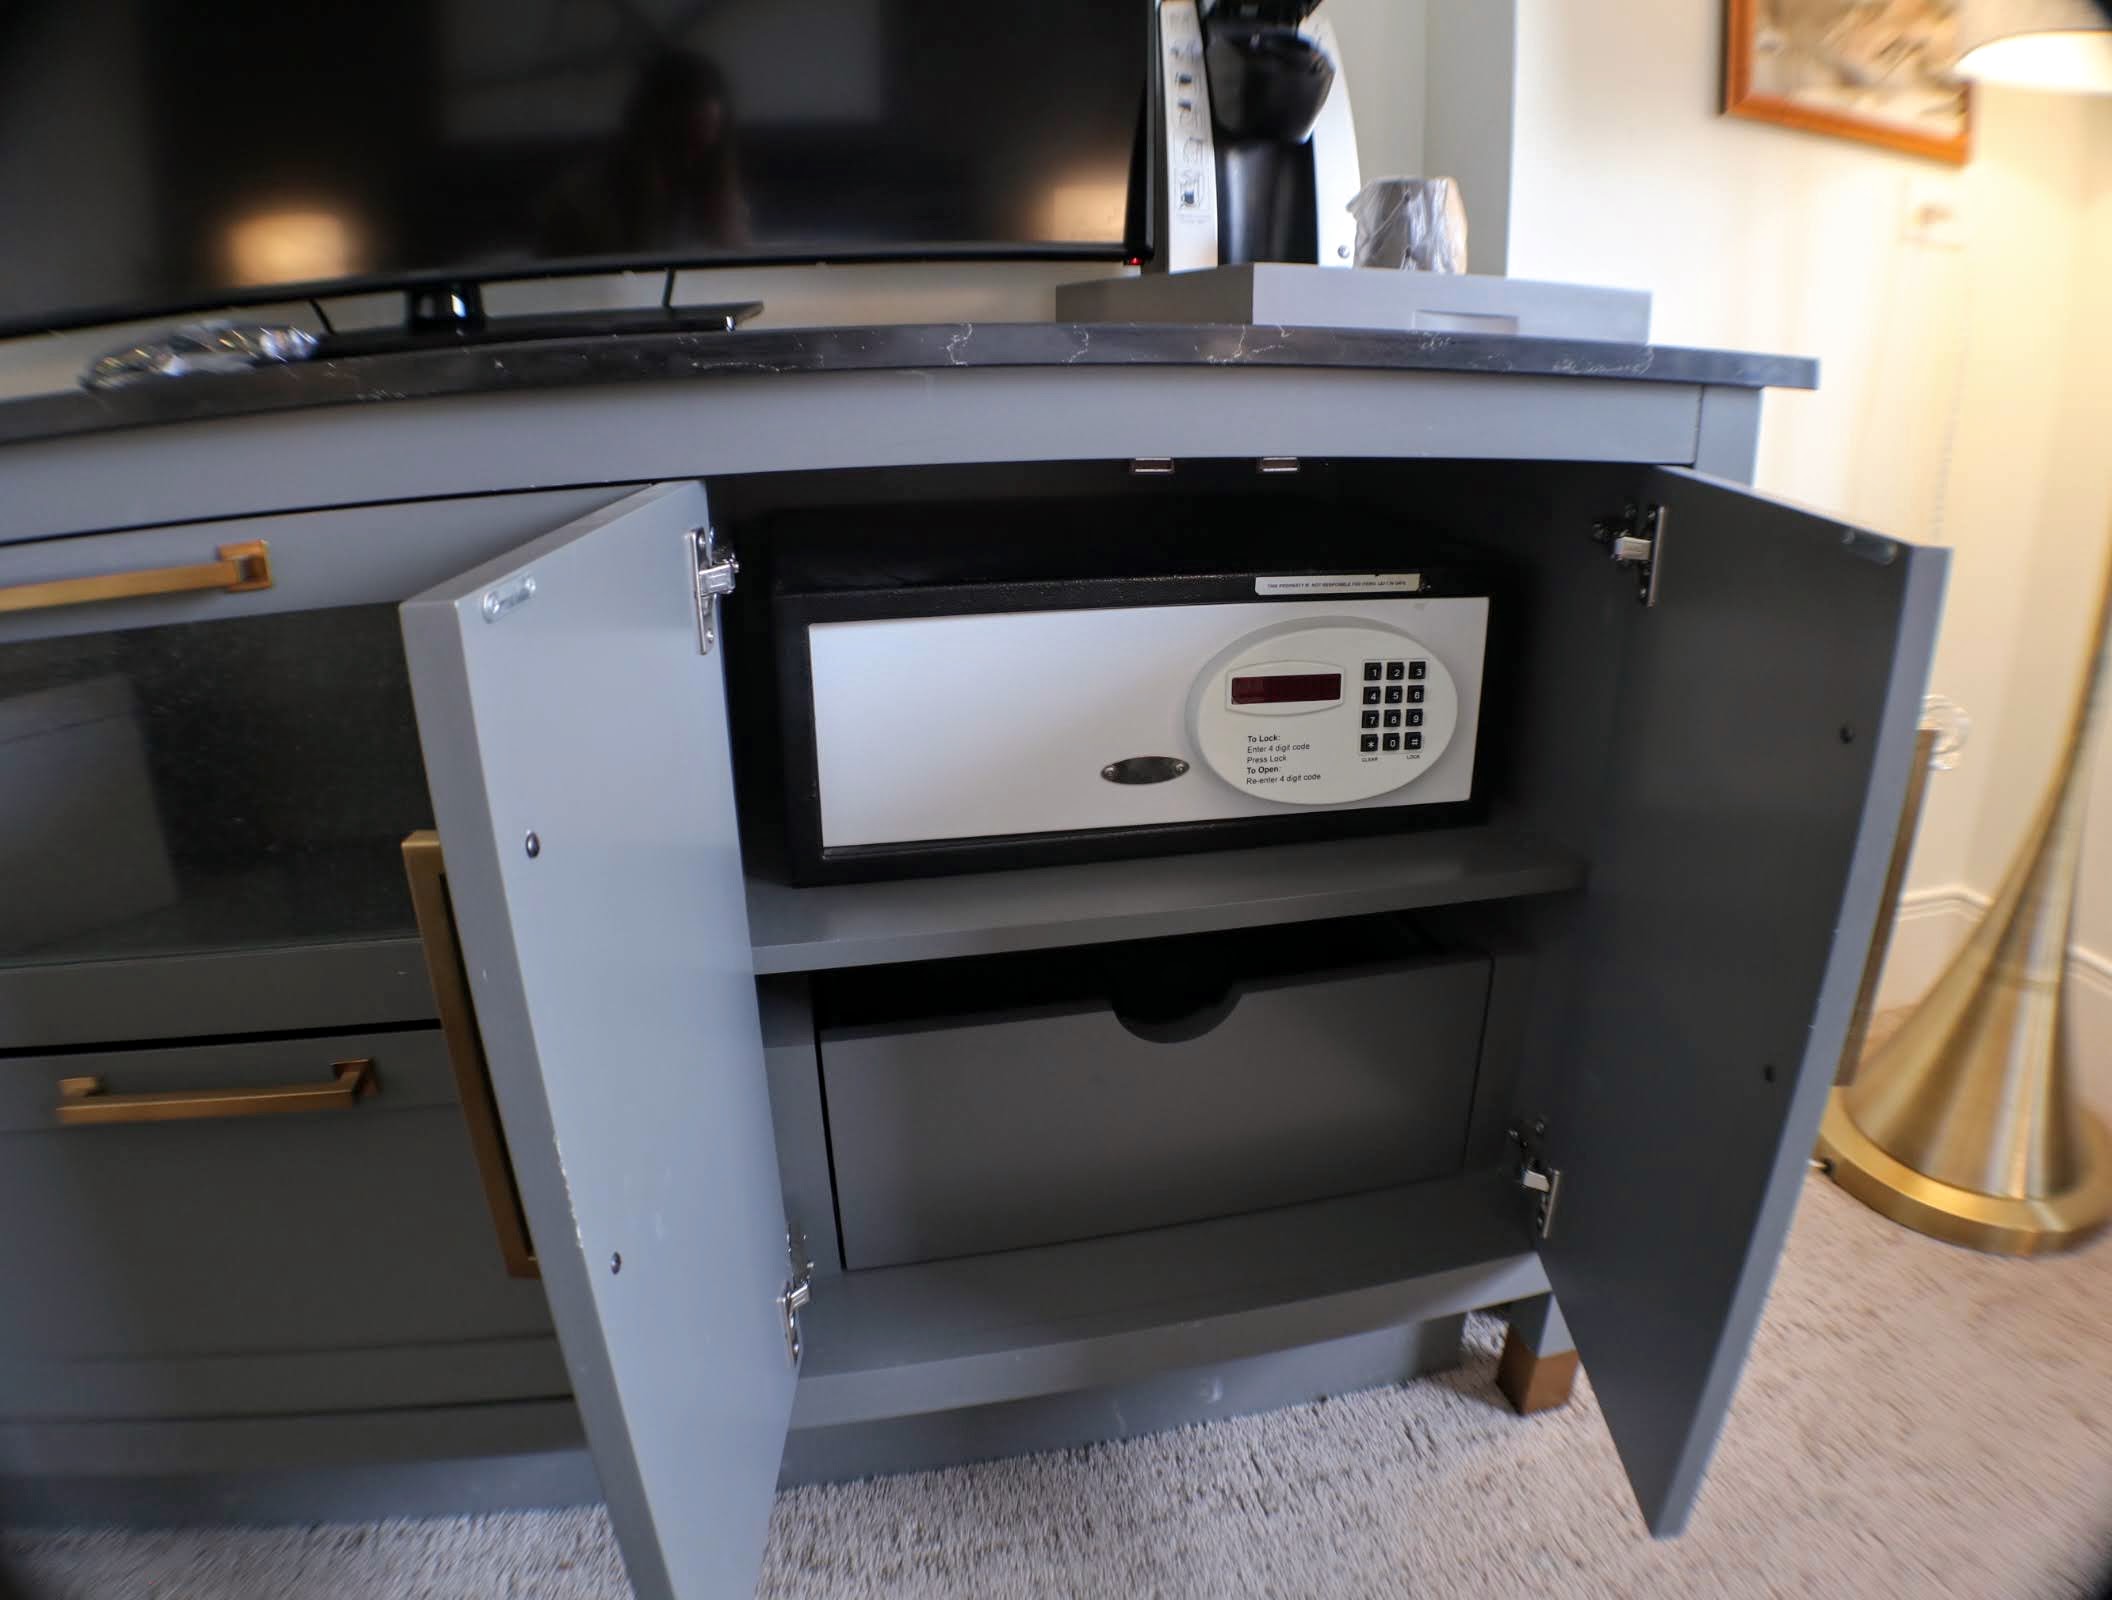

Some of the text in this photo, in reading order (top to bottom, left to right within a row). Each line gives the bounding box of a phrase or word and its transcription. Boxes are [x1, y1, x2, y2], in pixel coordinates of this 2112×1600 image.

[1394, 669, 1401, 677] 2
[1416, 668, 1422, 676] 3
[1370, 691, 1420, 701] 4 5 6
[1369, 715, 1419, 725] 7 8 9
[1247, 734, 1281, 743] To Lock:
[1390, 739, 1396, 747] 0
[1247, 745, 1267, 754] Enter
[1275, 743, 1290, 753] digit
[1292, 743, 1310, 751] code
[1247, 754, 1287, 764] Press Lock
[1247, 767, 1256, 775] To
[1246, 776, 1278, 785] Re-enter
[1286, 774, 1302, 784] digit
[1303, 773, 1321, 781] code
